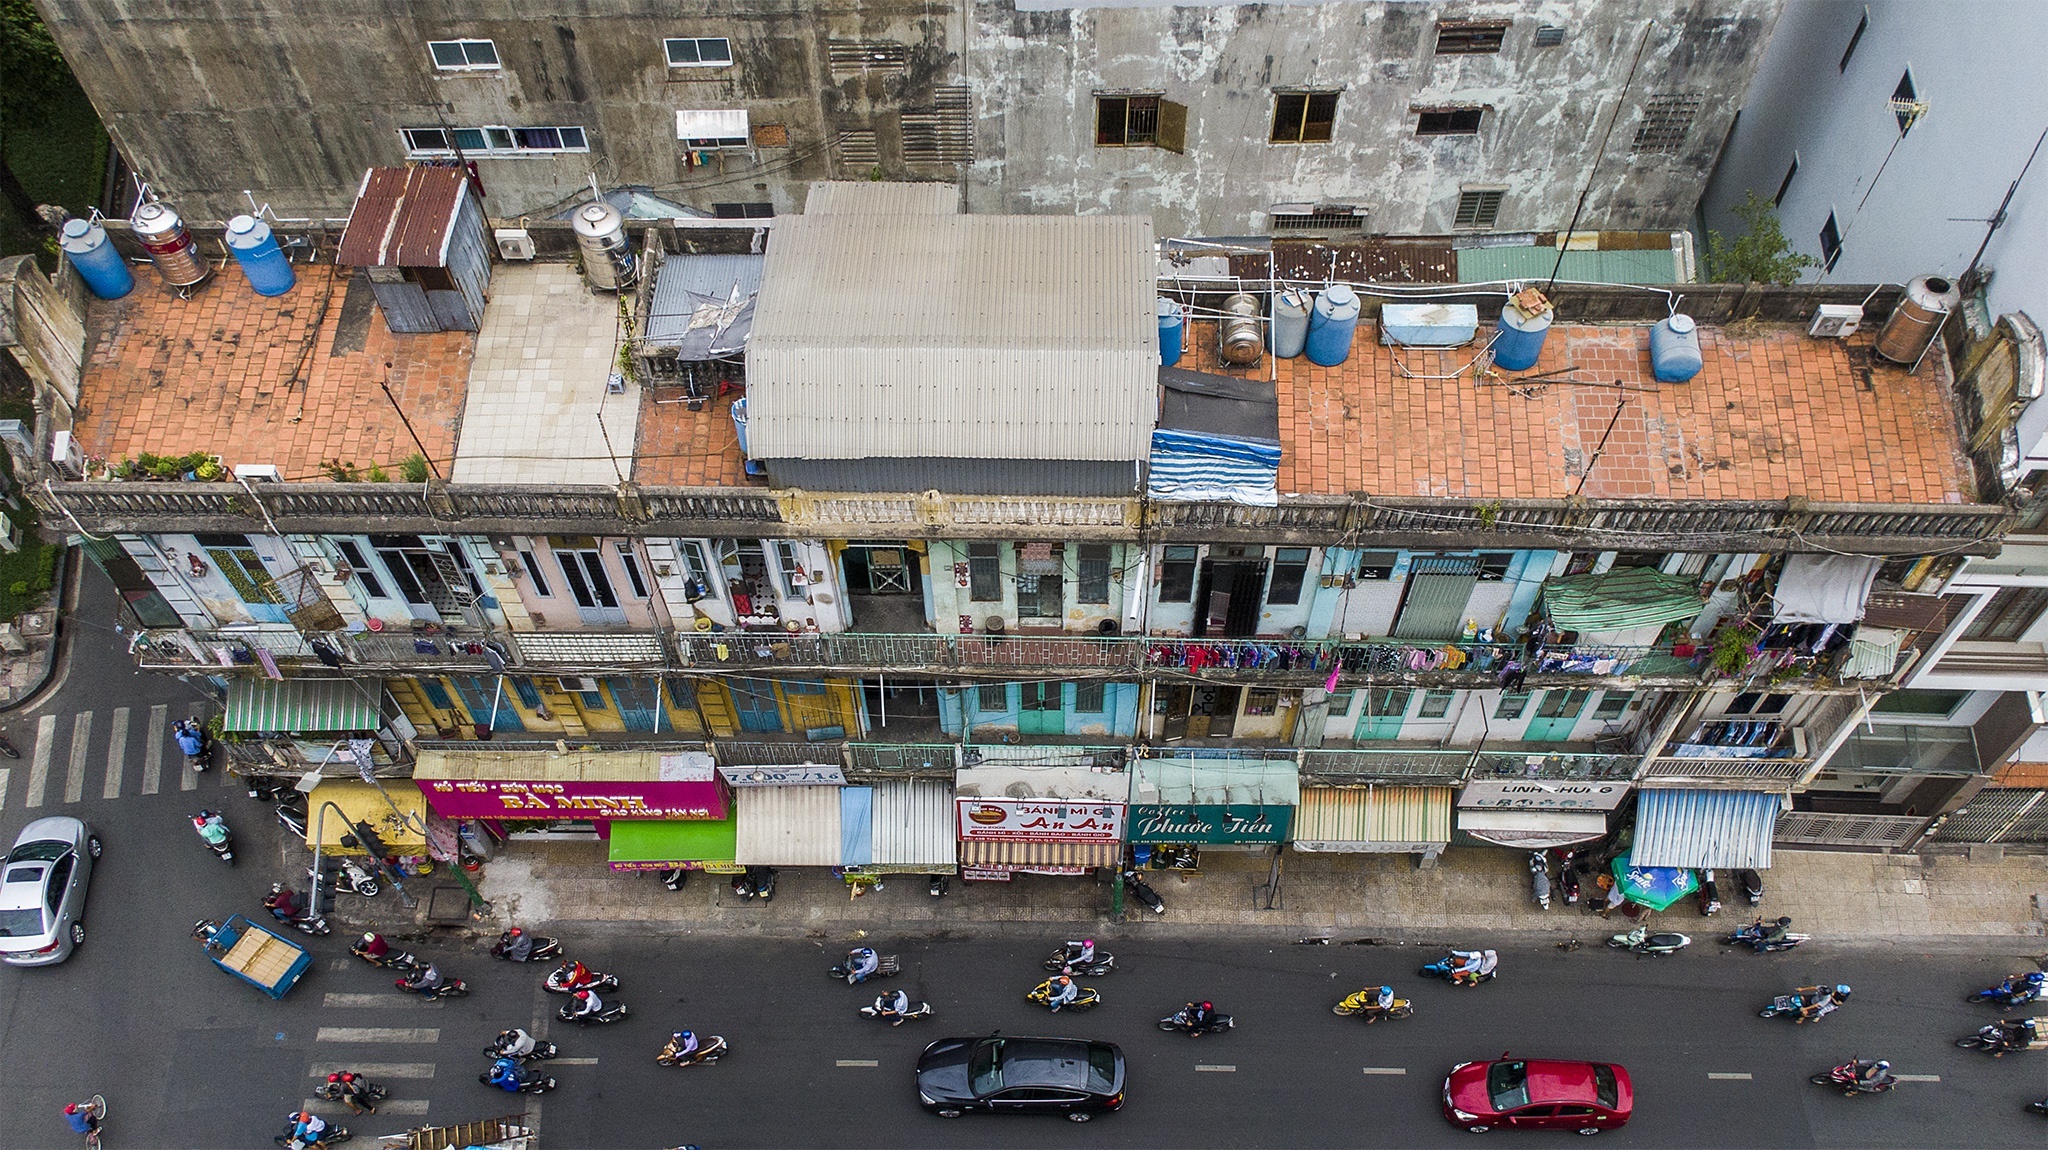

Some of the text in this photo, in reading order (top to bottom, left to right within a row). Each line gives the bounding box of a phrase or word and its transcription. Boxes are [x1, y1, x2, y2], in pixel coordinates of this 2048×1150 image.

[1554, 786, 1613, 794] HUG
[498, 792, 648, 809] BÀ MINH
[1070, 806, 1088, 815] MÌ
[1020, 816, 1115, 830] An An
[1627, 870, 1652, 889] Sprite
